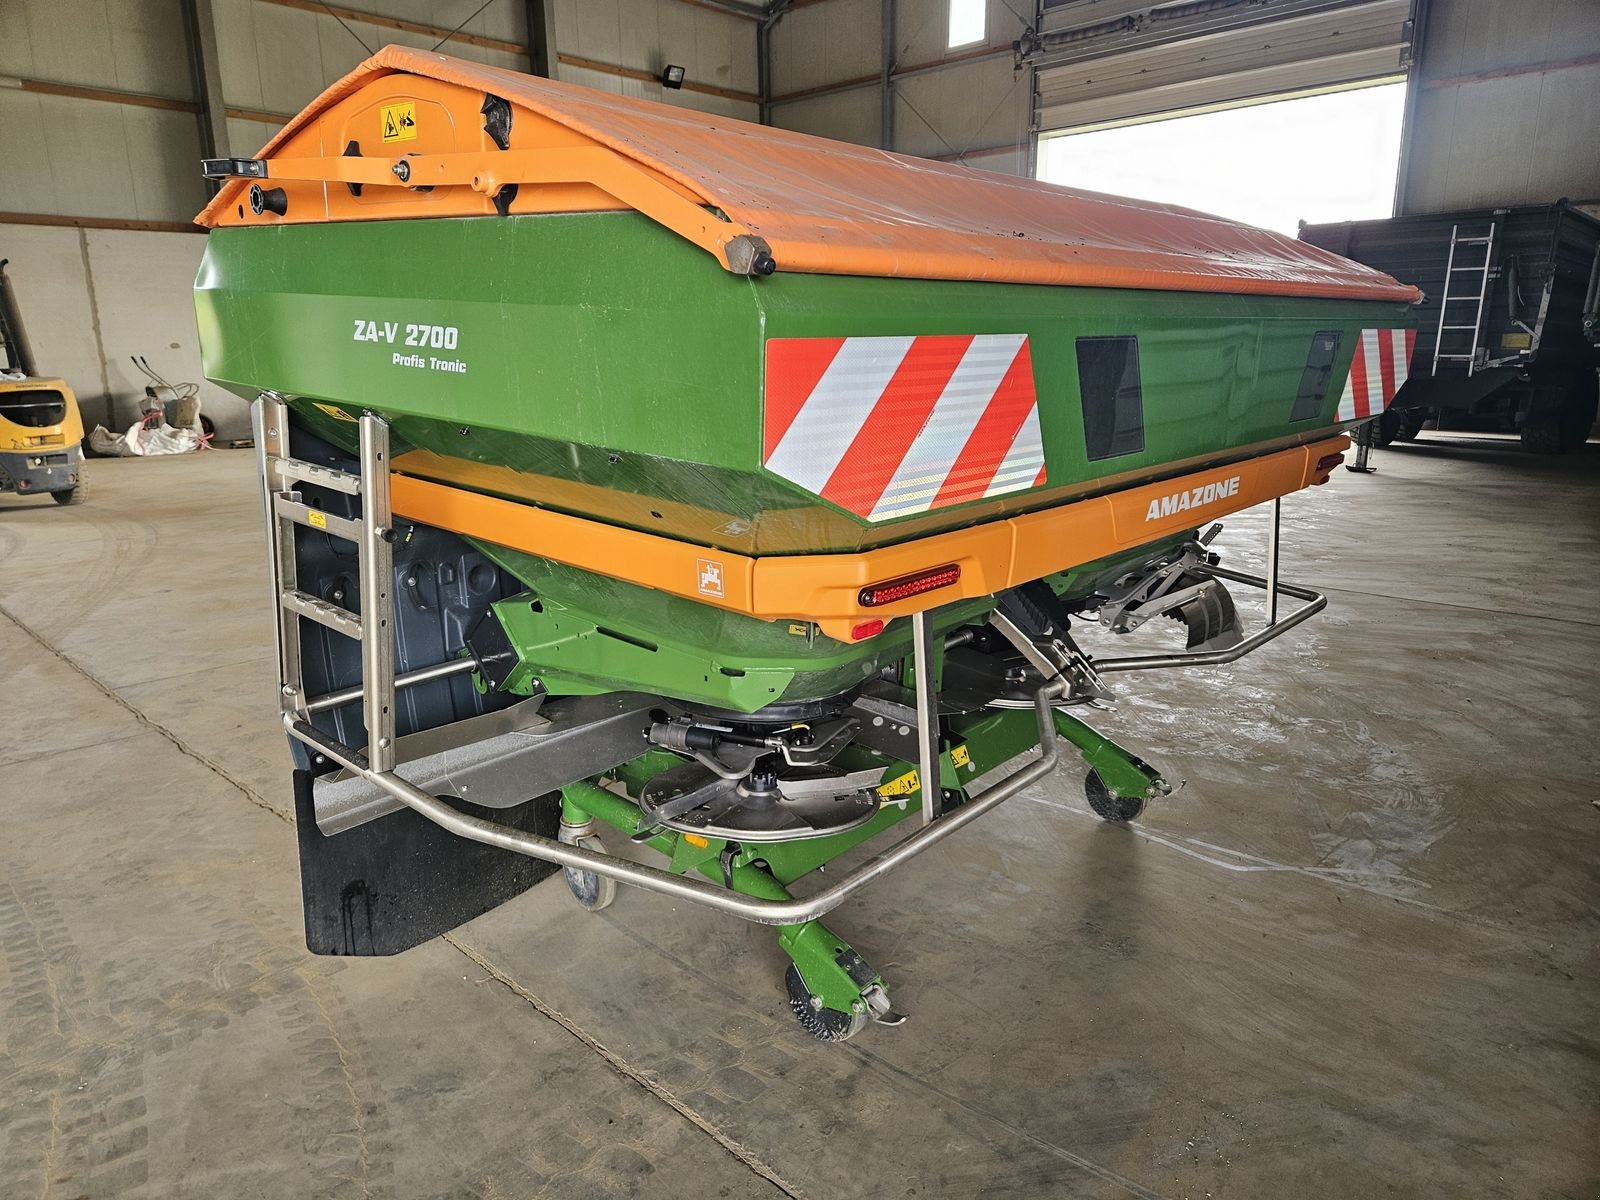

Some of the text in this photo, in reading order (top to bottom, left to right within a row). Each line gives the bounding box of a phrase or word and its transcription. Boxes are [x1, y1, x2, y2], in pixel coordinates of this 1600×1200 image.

[353, 319, 459, 350] ZA-V 2700
[392, 352, 467, 373] Profis Tronic
[1145, 475, 1241, 522] AMAZONE
